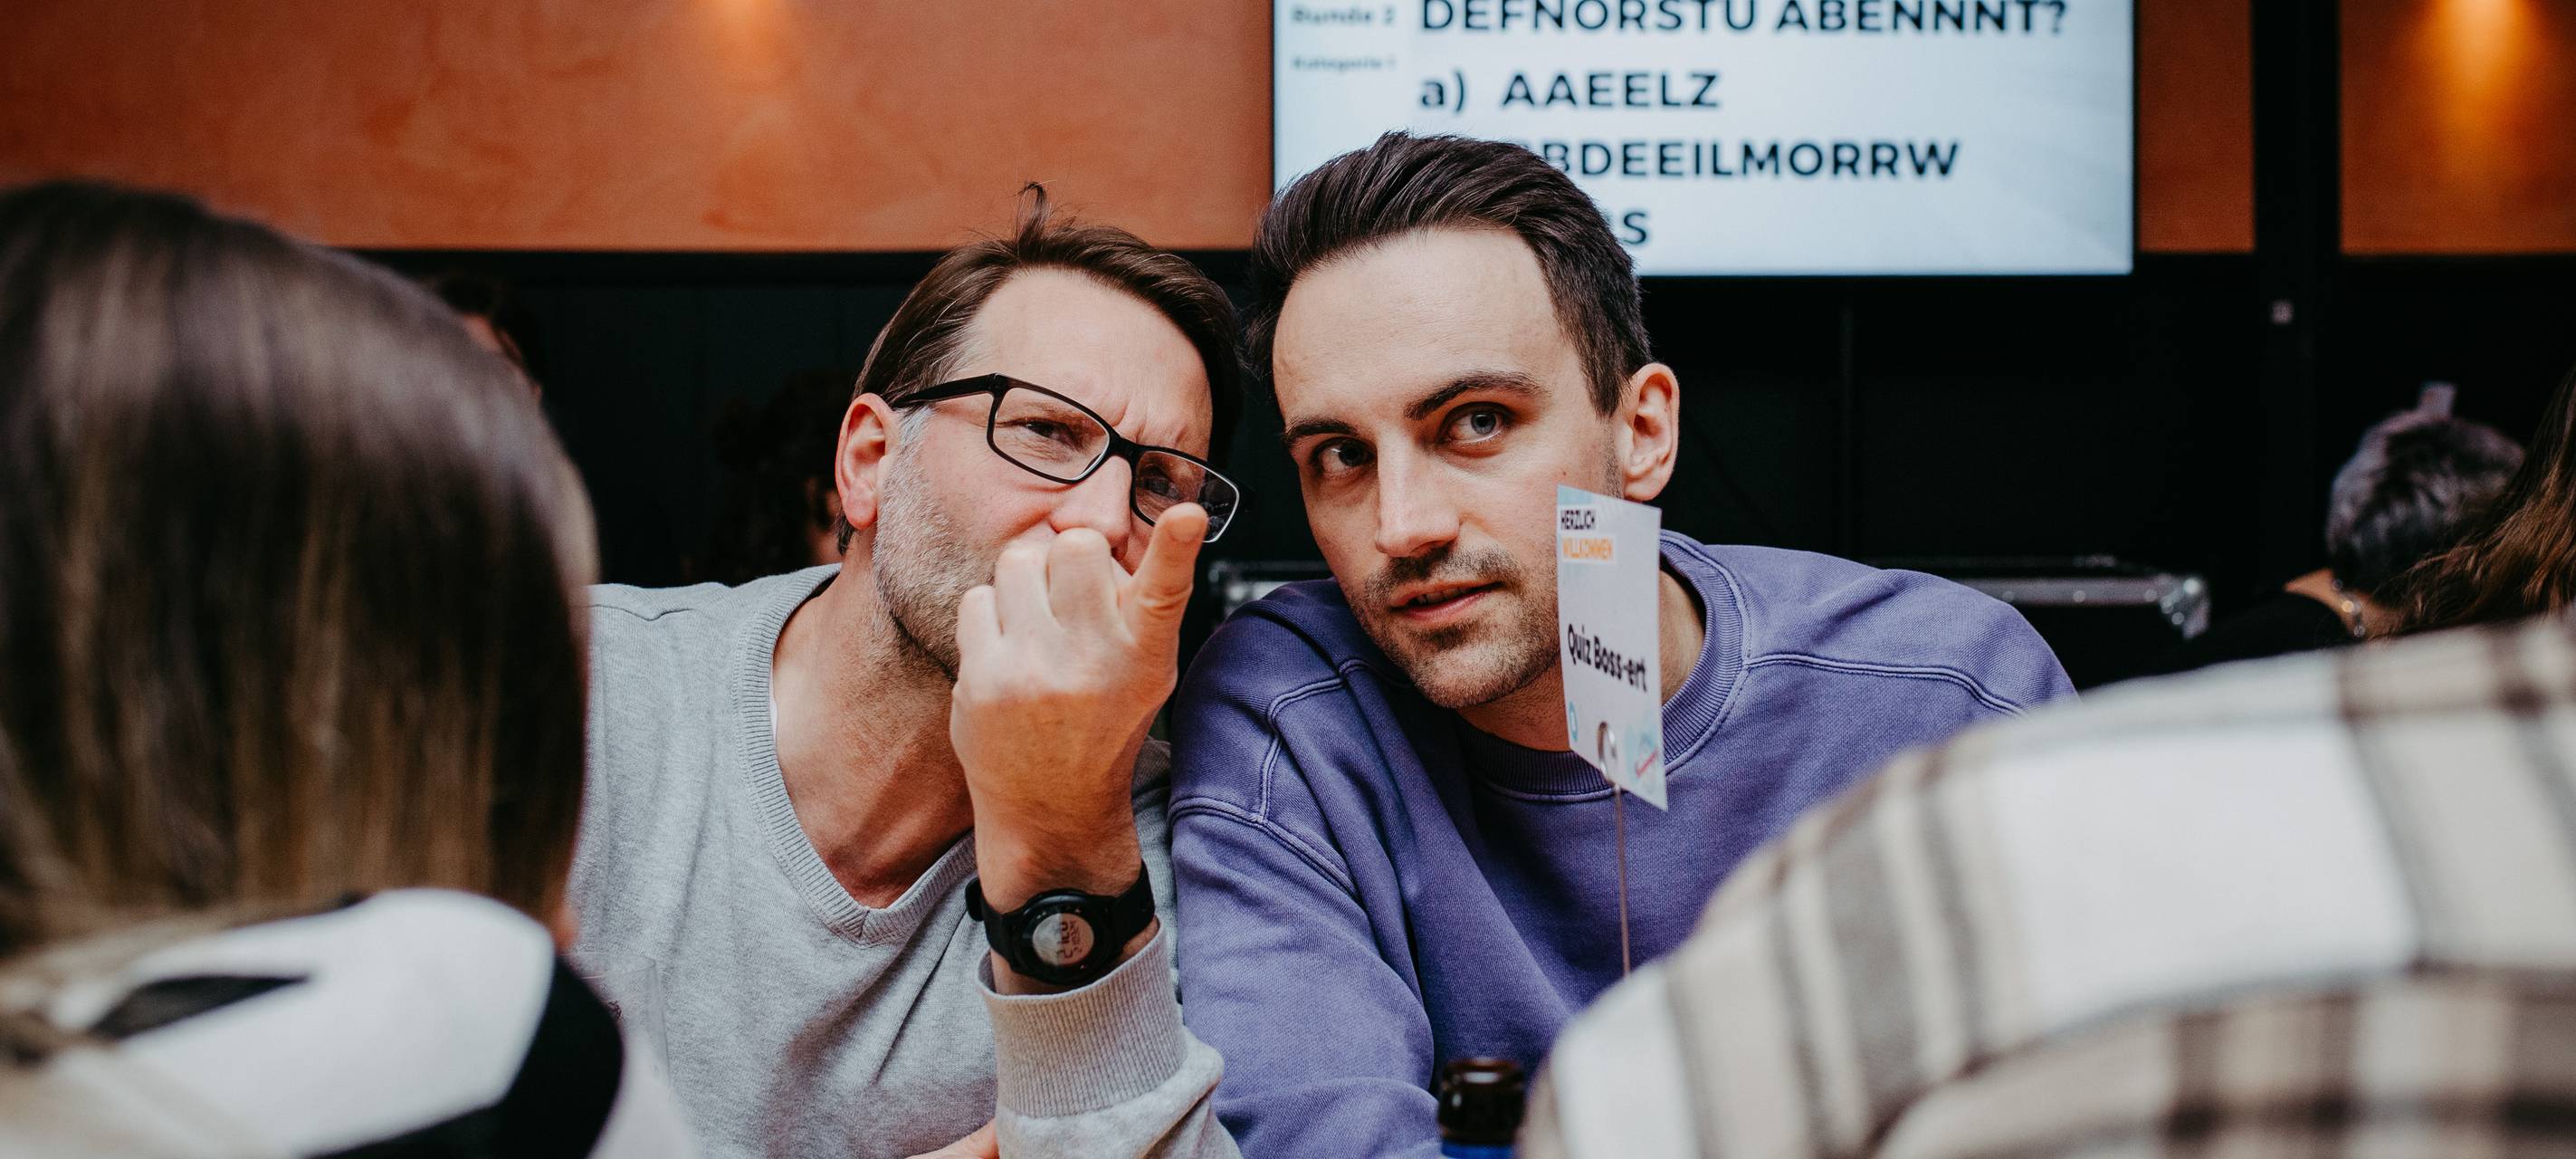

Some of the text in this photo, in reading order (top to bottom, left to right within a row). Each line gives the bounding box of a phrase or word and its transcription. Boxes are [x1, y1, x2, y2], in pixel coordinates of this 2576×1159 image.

[1423, 0, 2066, 33] DEFNORSTU ABENNNT?
[1421, 72, 1718, 111] a) AAEELZ
[1524, 142, 1958, 176] BDEEILMORRW
[1560, 509, 1596, 531] HERZLICH
[1562, 537, 1613, 560] WILLKOMMEN
[1568, 623, 1647, 693] Quiz Boss-ert
